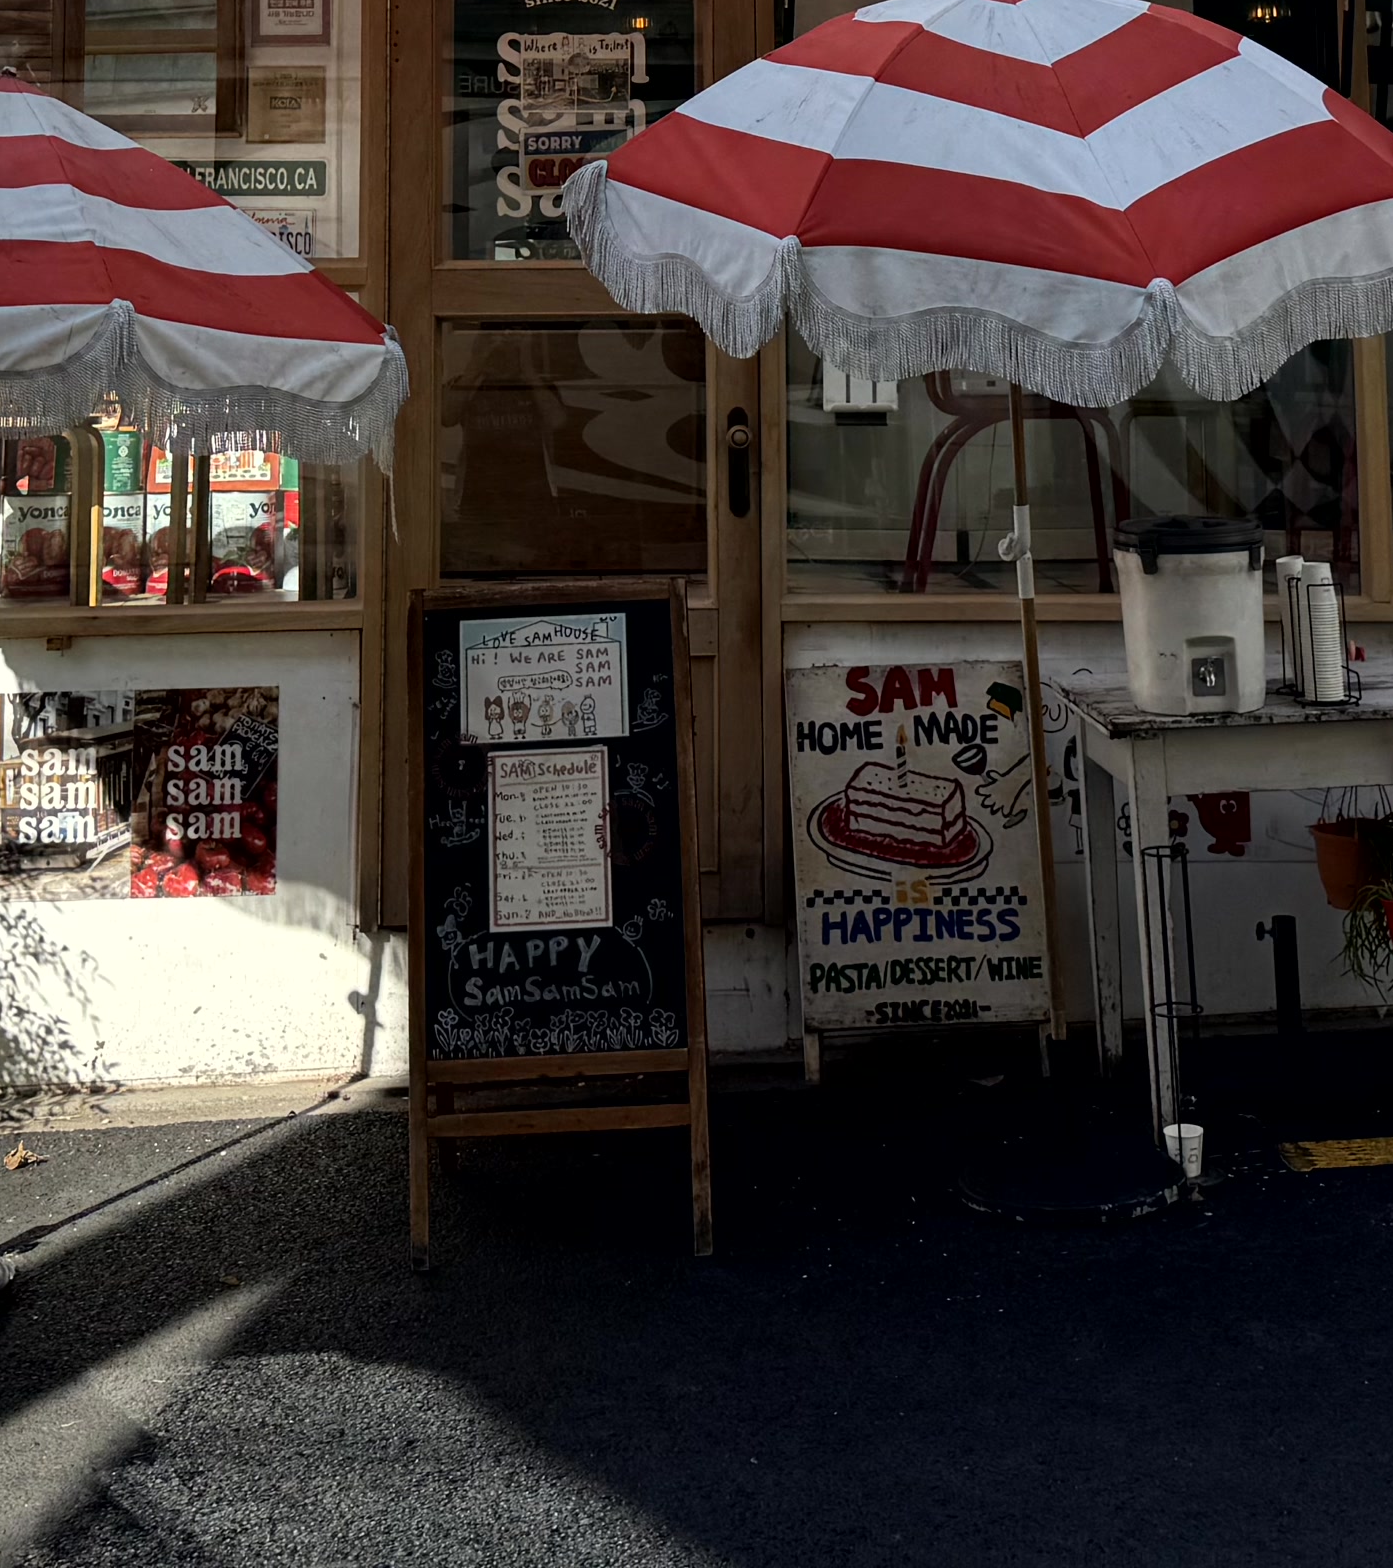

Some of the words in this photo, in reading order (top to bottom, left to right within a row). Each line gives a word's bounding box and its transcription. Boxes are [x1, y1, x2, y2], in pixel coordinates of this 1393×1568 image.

[524, 39, 557, 53] Where
[528, 135, 582, 151] SORRY
[195, 168, 291, 191] FRANCISCO,
[295, 168, 317, 190] CA
[103, 504, 141, 518] onca
[482, 631, 516, 649] LOVE
[524, 632, 553, 647] SAM
[554, 624, 599, 642] HOUSE
[537, 650, 566, 664] ARE
[576, 647, 609, 660] SAM
[575, 662, 611, 674] SAM
[575, 676, 612, 688] SAM
[846, 666, 958, 716] SAM
[797, 720, 883, 755] HOME
[914, 712, 999, 747] MADE
[20, 748, 98, 776] sam
[167, 744, 244, 772] sam
[500, 761, 532, 779] SAM
[537, 759, 597, 777] Schedule
[19, 780, 97, 810] sam
[166, 777, 243, 806] sam
[18, 815, 97, 844] sam
[165, 811, 242, 840] sam
[822, 908, 1021, 945] HAPPINESS
[468, 934, 601, 974] HAPPY
